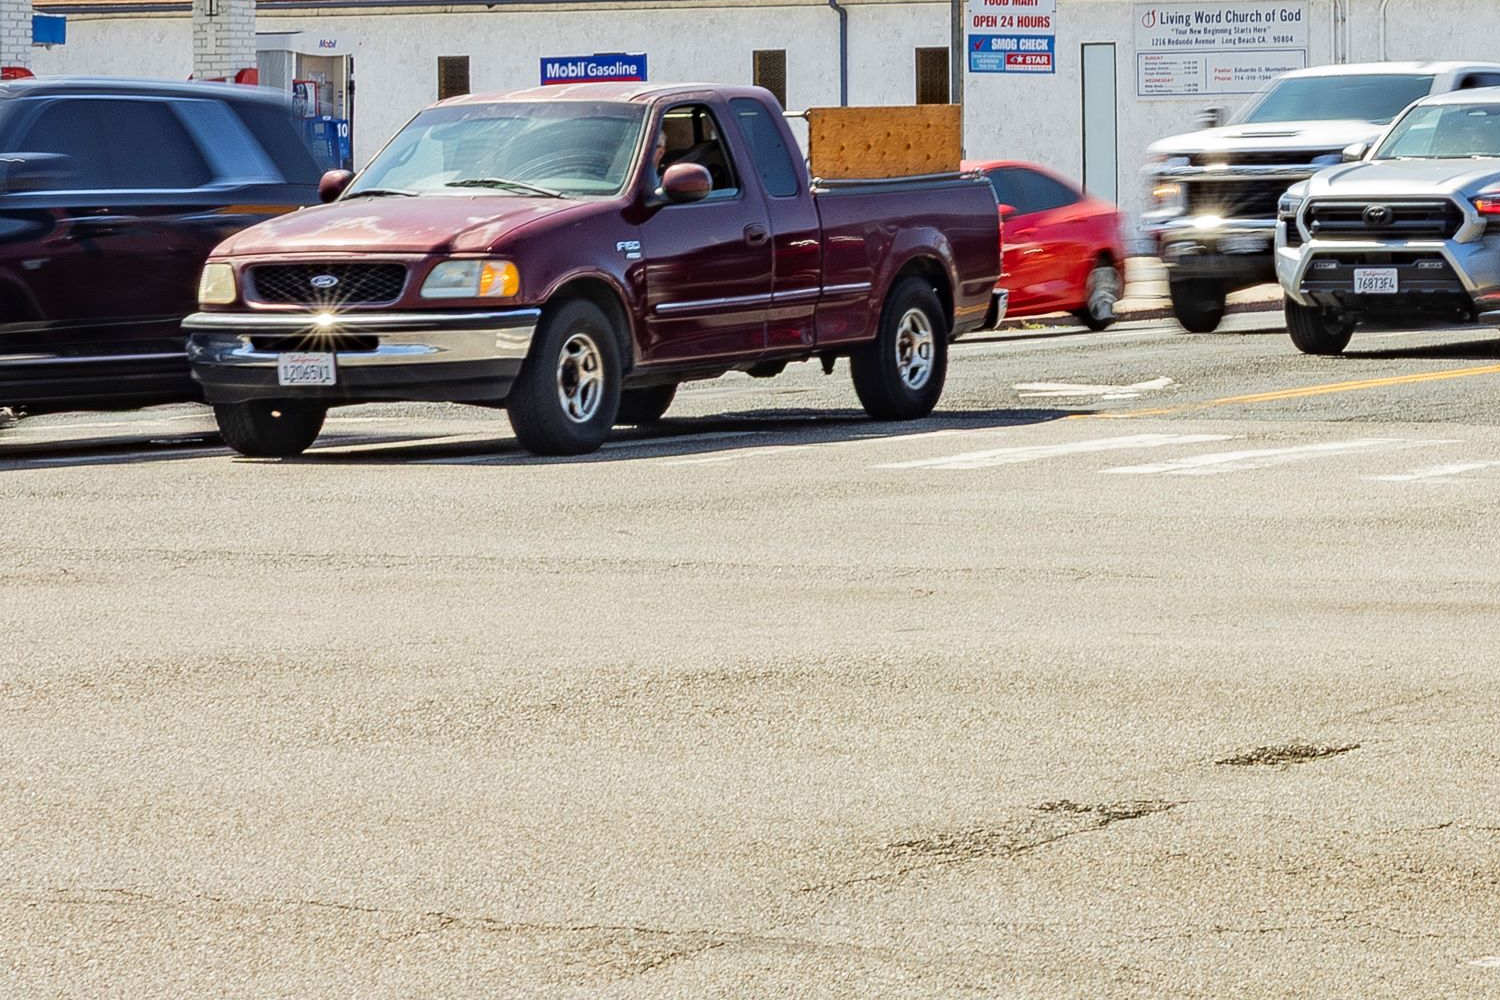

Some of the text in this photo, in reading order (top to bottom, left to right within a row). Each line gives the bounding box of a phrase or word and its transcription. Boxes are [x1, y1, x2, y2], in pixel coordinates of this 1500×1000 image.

[973, 15, 1051, 28] OPEN 24 HOURS
[1160, 8, 1301, 27] Living Word Church of God
[1189, 27, 1202, 35] New
[1203, 26, 1232, 36] Beginning
[1233, 26, 1252, 34] Starts
[318, 39, 337, 49] Mobil
[991, 38, 1049, 51] SMOG CHECK
[1151, 38, 1167, 46] 1216
[1167, 38, 1193, 46] Redondo
[1194, 37, 1216, 45] Avenue
[1221, 37, 1236, 46] Long
[1237, 36, 1256, 44] Beach
[1272, 35, 1294, 43] 90804
[1025, 55, 1048, 65] STAR
[546, 62, 638, 78] Mobil Gasoline
[337, 123, 348, 138] 10
